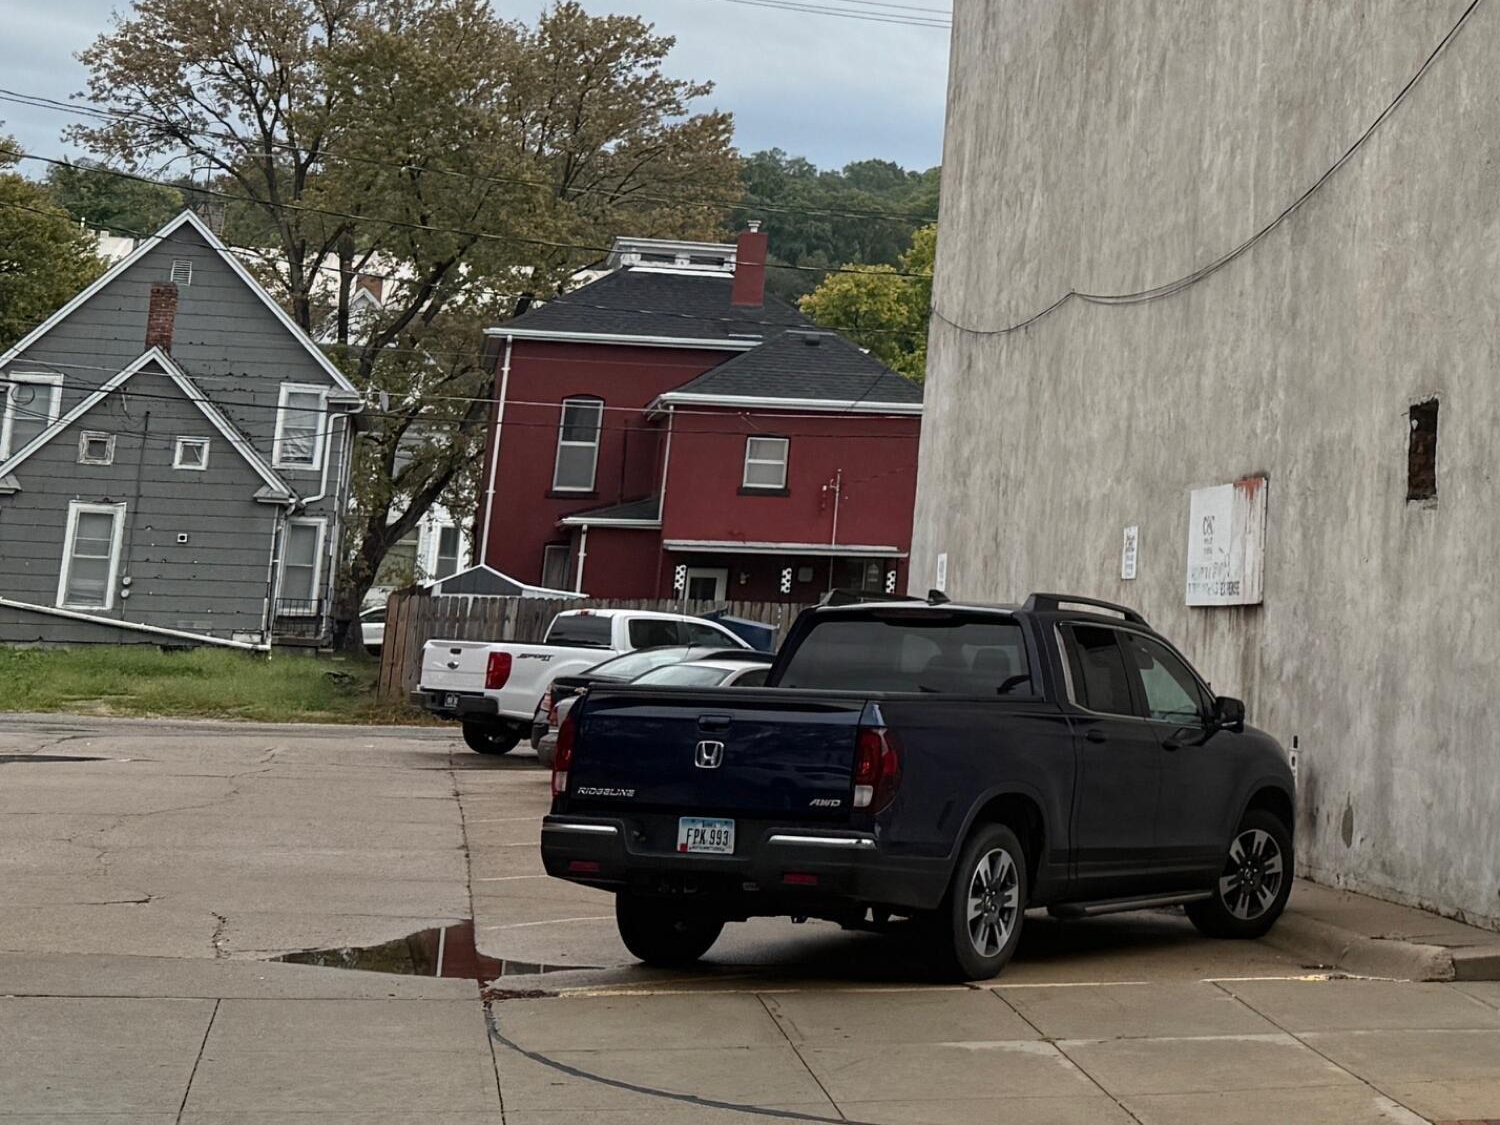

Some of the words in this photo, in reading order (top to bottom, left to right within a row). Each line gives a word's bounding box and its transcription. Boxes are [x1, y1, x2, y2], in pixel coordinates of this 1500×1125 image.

[577, 786, 636, 797] RIDGELINE
[809, 798, 841, 807] AWD
[686, 827, 707, 845] FPK
[709, 829, 729, 847] 993
